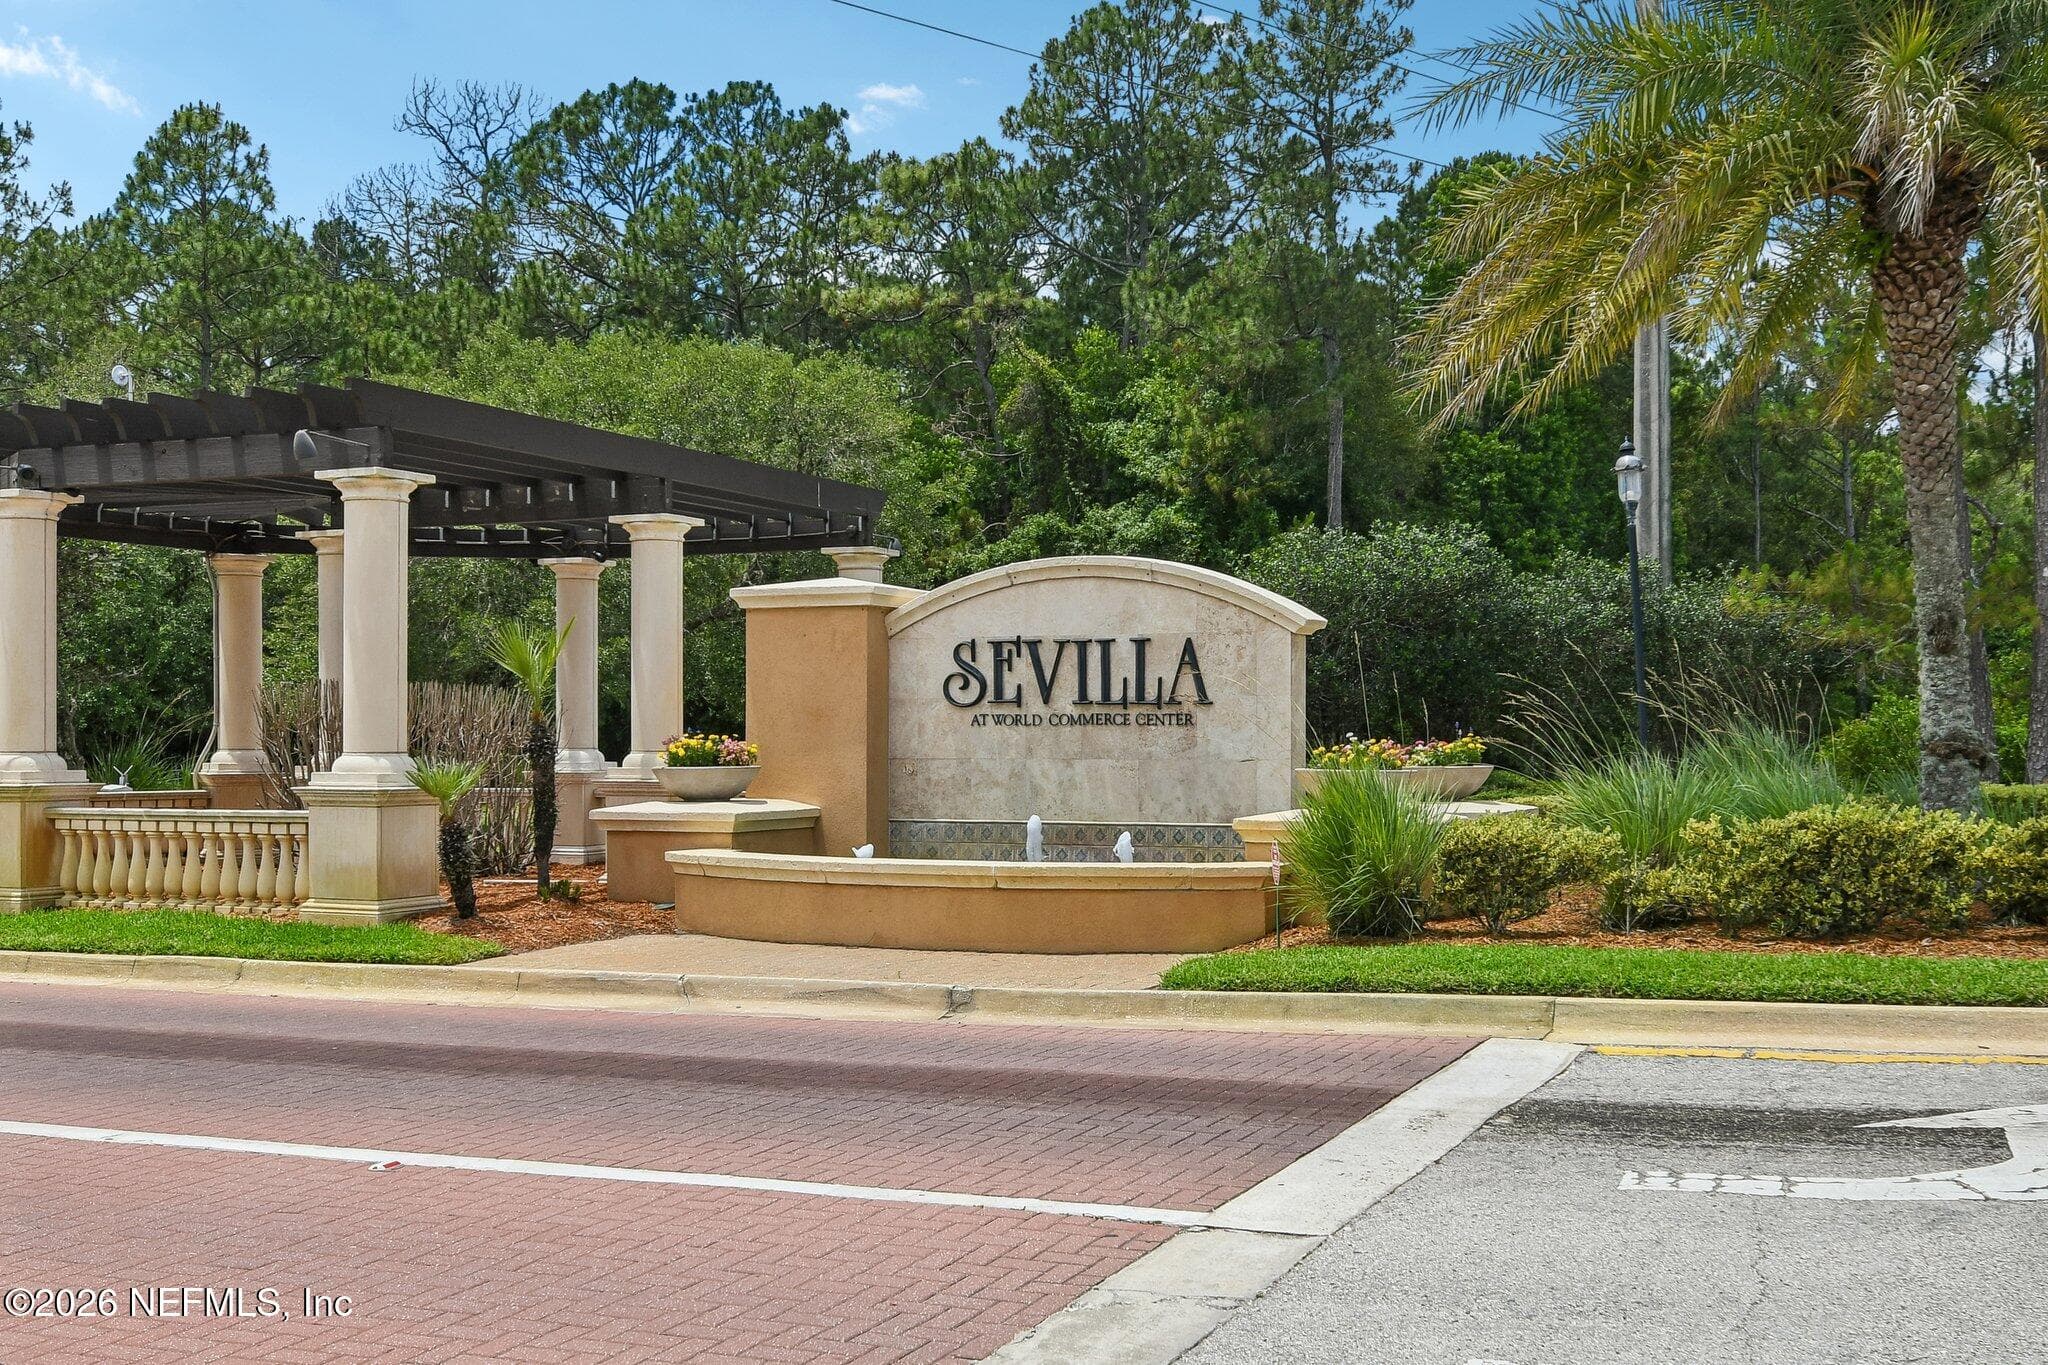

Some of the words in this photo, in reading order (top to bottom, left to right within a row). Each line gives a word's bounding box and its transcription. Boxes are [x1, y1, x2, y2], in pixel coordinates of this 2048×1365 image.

[943, 635, 1213, 709] SEVILLA
[970, 713, 989, 727] AT
[991, 713, 1043, 727] WORLD
[1048, 713, 1131, 727] COMMERCE
[1135, 713, 1195, 727] CENTER
